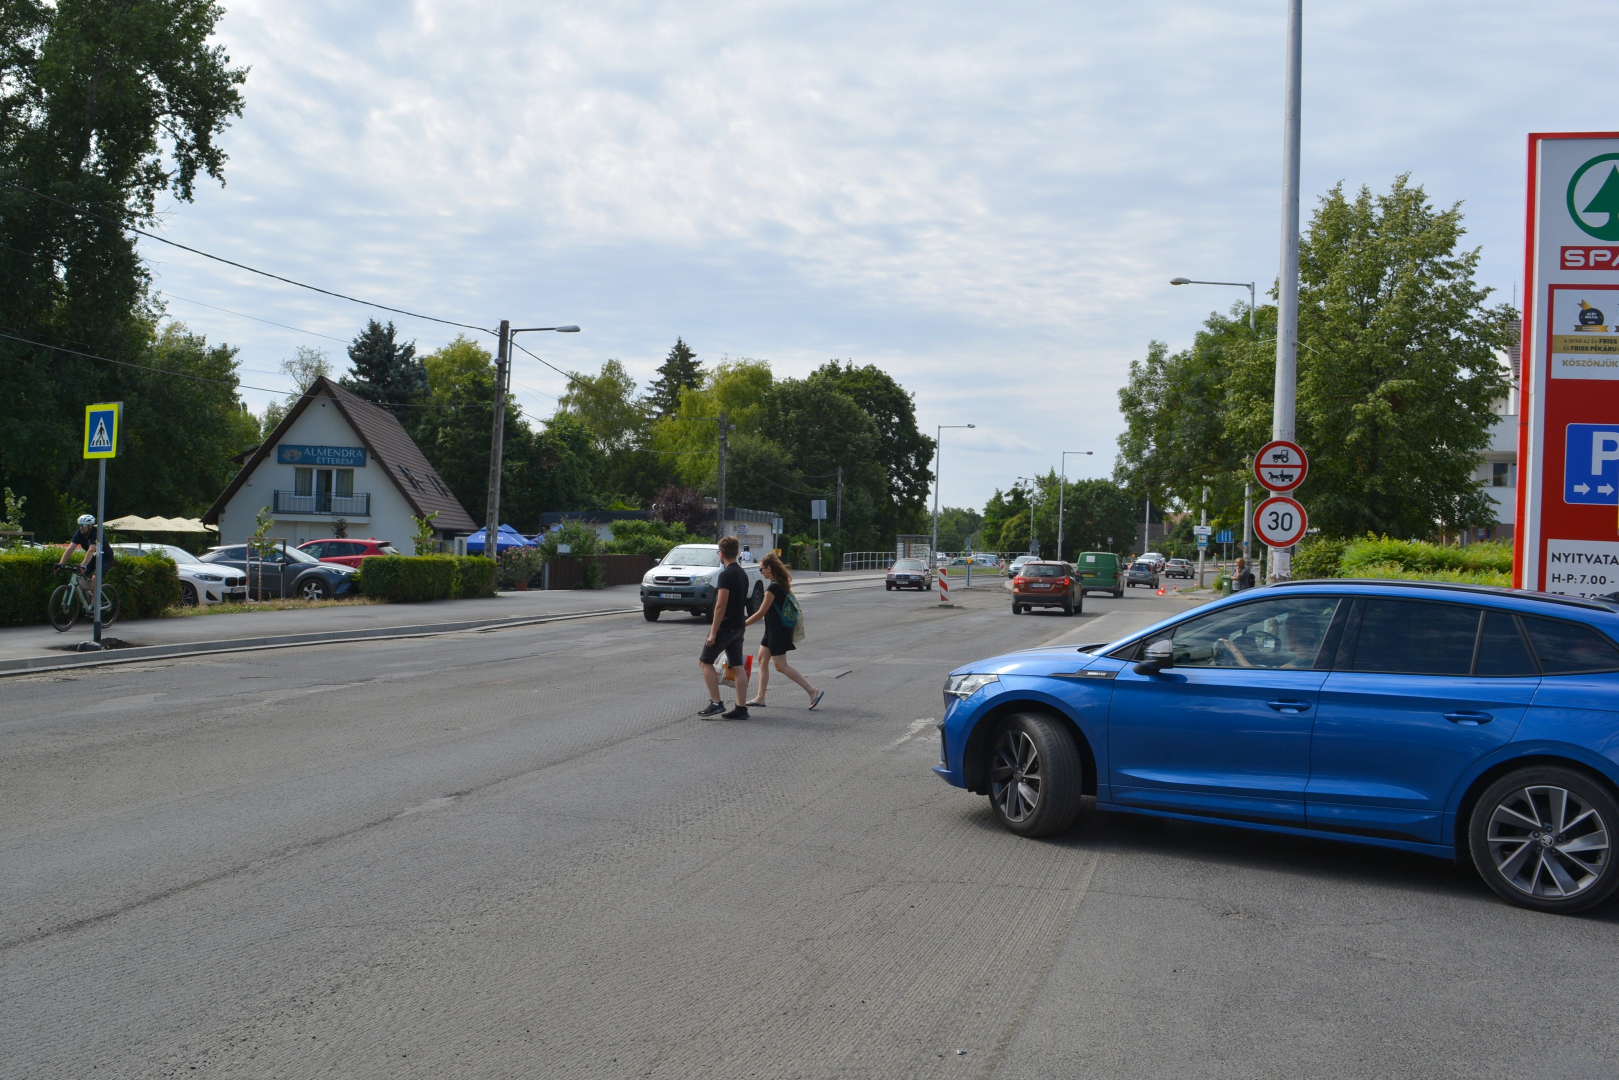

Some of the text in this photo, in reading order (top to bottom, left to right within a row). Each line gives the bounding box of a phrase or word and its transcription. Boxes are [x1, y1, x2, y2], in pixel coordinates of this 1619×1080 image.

[1590, 344, 1617, 352] PÉKÁRU
[1562, 358, 1619, 368] KÖSZÖNJÜK
[303, 448, 363, 457] ALMENDRA
[1591, 431, 1619, 476] P
[316, 456, 354, 465] ÉTTEREM
[1267, 511, 1294, 532] 30
[1551, 552, 1619, 565] NYITVATA
[1580, 575, 1607, 585] 7.00
